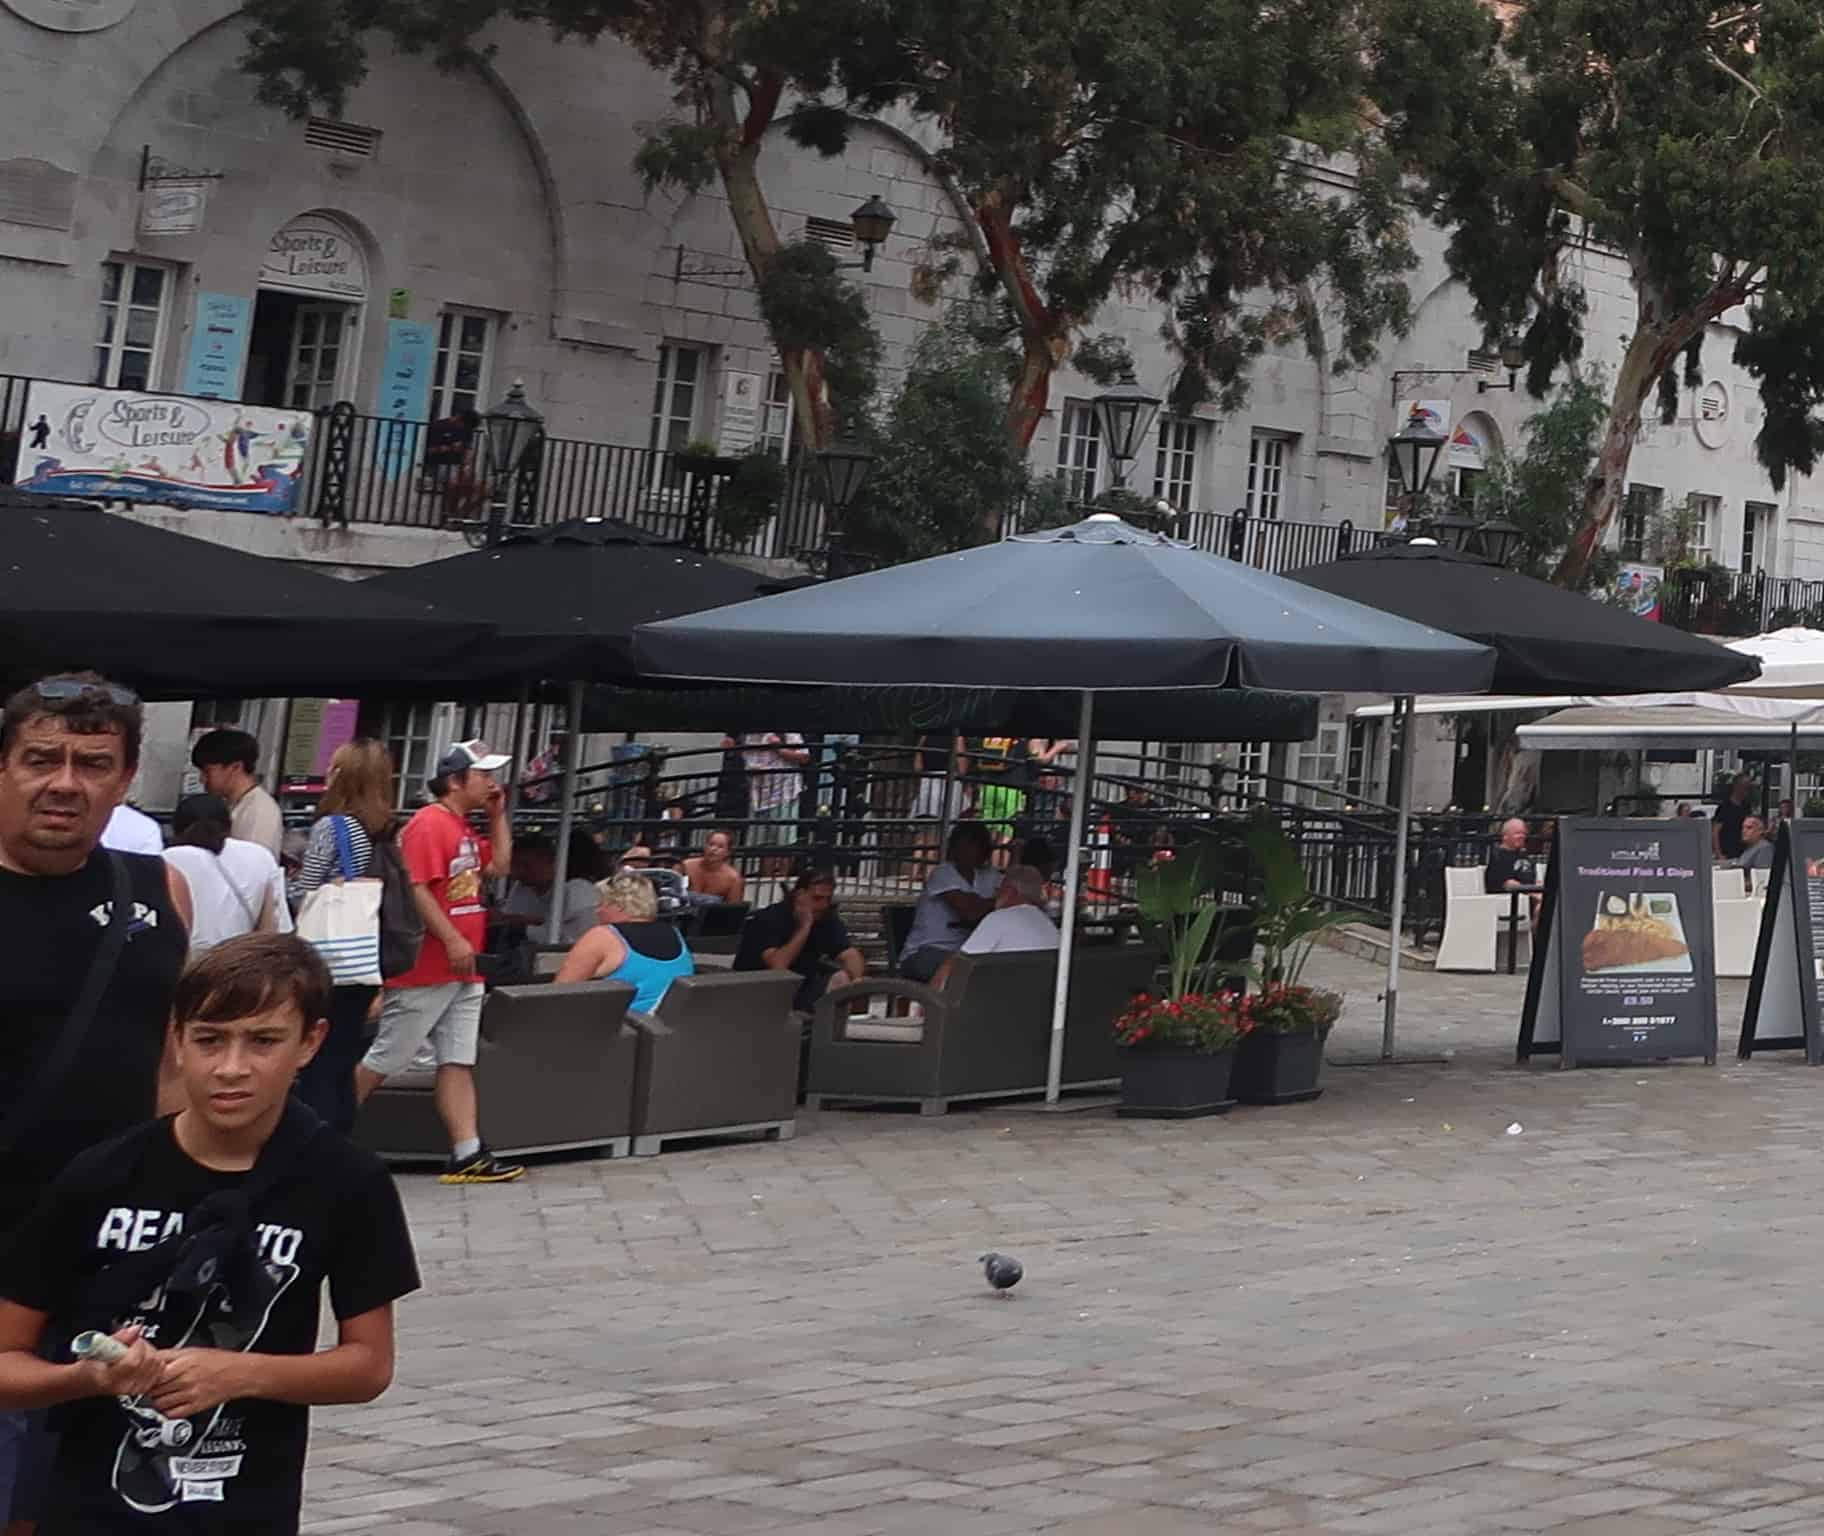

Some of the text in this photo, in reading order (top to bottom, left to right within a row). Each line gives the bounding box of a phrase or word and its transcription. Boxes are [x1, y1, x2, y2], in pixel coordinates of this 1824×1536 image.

[269, 230, 339, 258] Sports &
[288, 256, 347, 276] Leisure
[109, 399, 185, 429] Sports &
[131, 430, 195, 447] Leisure
[97, 1207, 185, 1252] REA
